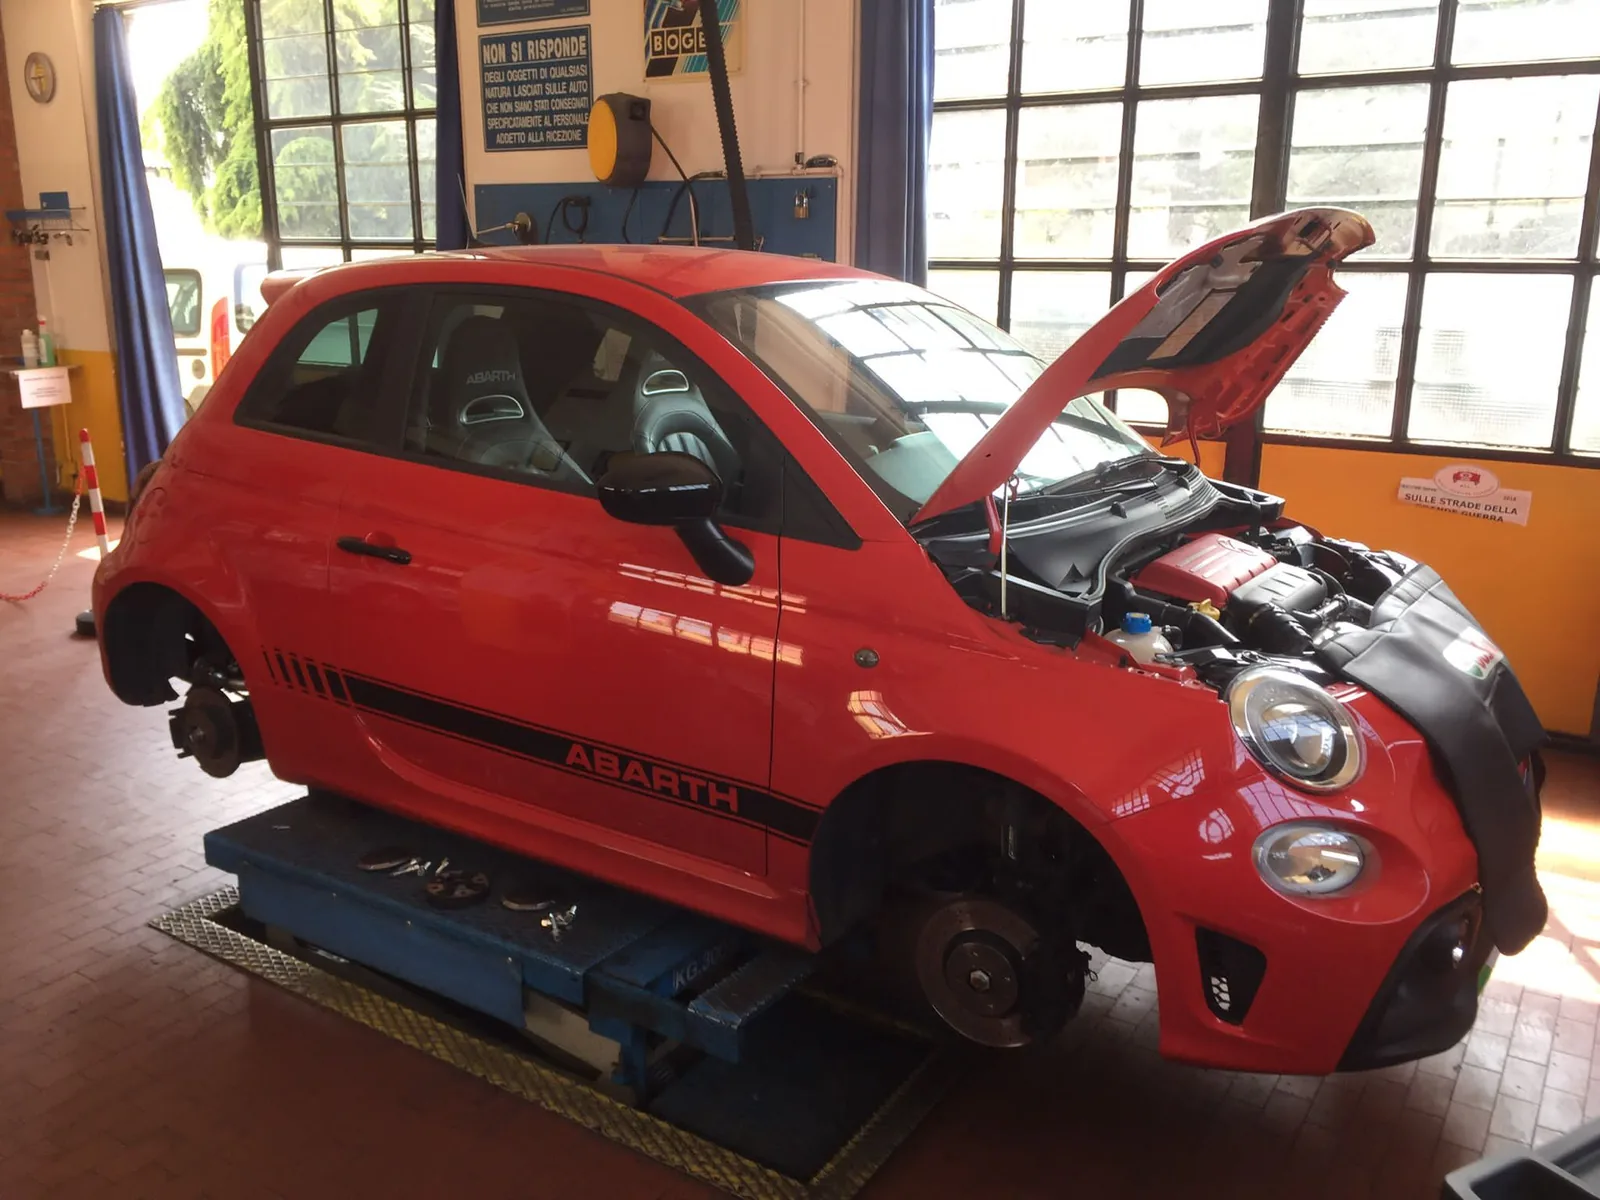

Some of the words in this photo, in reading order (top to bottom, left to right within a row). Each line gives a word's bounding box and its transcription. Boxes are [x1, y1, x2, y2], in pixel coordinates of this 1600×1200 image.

[483, 43, 506, 64] NON
[511, 41, 522, 62] SI
[527, 35, 587, 60] RISPONDE
[653, 31, 707, 52] BOGE
[484, 71, 505, 83] DEGLI
[507, 68, 538, 82] OGGETTI
[540, 67, 548, 79] DI
[550, 64, 588, 78] QUALSIASI
[485, 86, 511, 98] NATURA
[513, 83, 543, 97] LASCIATI
[545, 82, 567, 95] SULLE
[569, 80, 588, 93] AUTO
[486, 103, 499, 114] CHE
[500, 101, 513, 113] NON
[514, 101, 532, 112] SIANO
[534, 99, 549, 111] STATI
[551, 97, 589, 110] CONSEGNATI
[487, 115, 542, 130] SPECIFICATAMENTE
[544, 114, 552, 126] AL
[554, 112, 589, 126] PERSONALE
[528, 131, 544, 143] ALLA
[546, 129, 582, 142] RICEZIONE
[466, 370, 516, 385] ABARTH
[1405, 493, 1437, 504] SULLE
[1440, 497, 1481, 511] STRADE
[1484, 503, 1518, 515] DELLA
[565, 743, 739, 813] ABARTH
